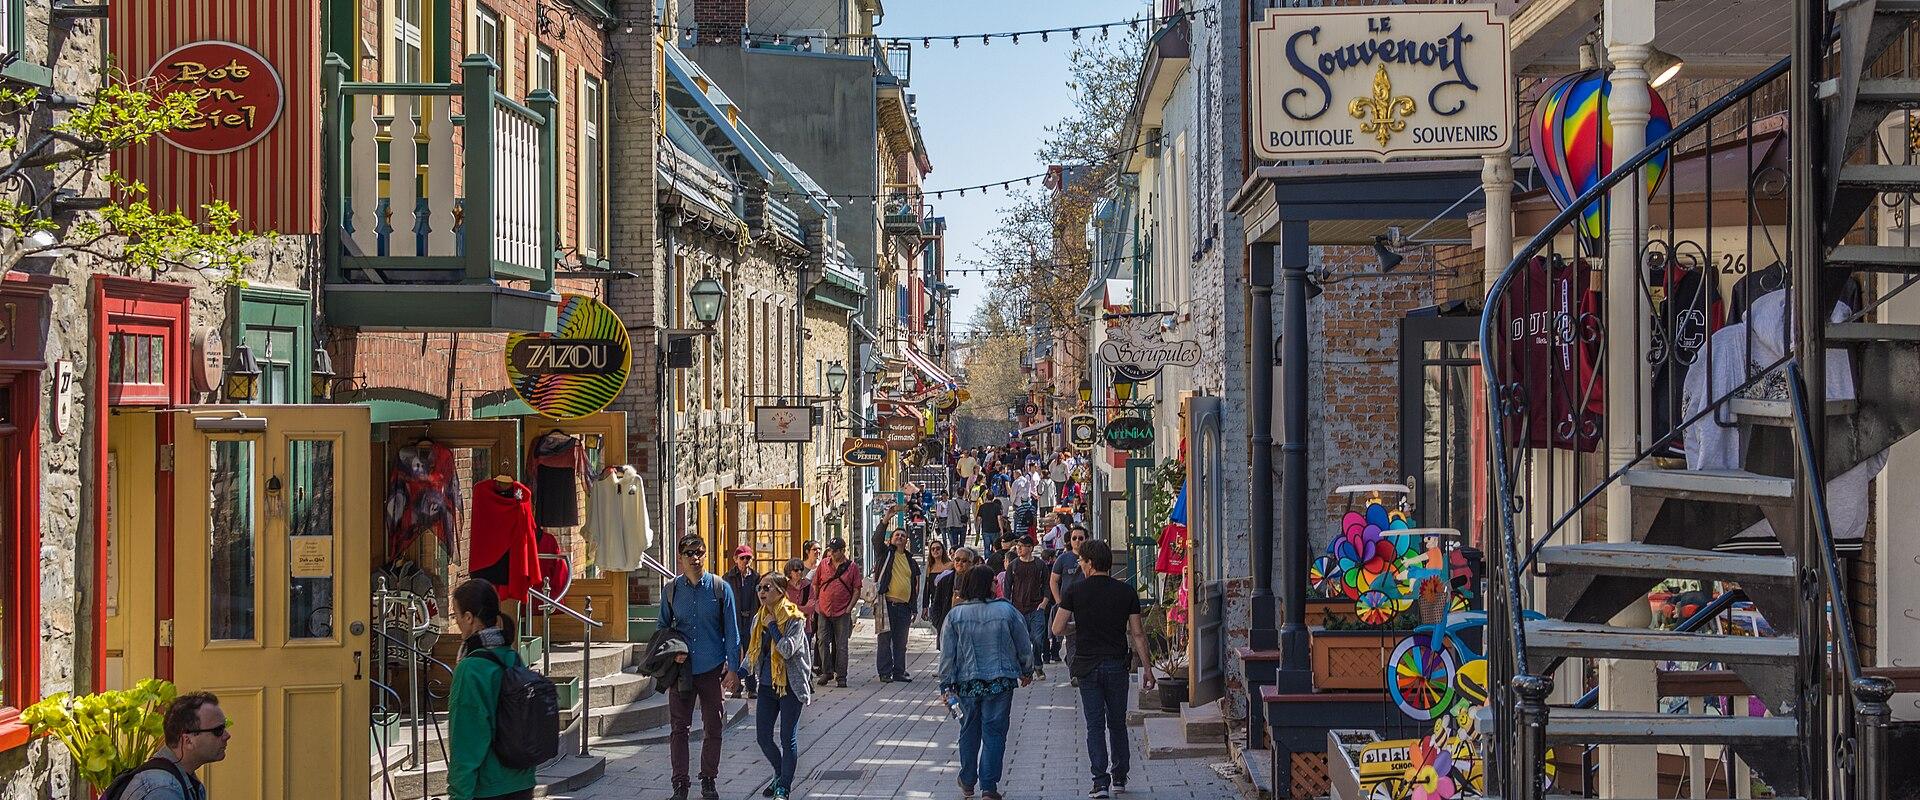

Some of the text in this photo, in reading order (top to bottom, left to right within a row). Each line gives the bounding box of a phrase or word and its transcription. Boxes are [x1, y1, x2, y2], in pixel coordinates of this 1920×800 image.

[1368, 16, 1391, 33] LE
[170, 58, 250, 83] Pot
[189, 86, 245, 101] en
[1269, 125, 1498, 148] BOUTIQUE SOUVENIRS
[1721, 253, 1746, 275] 26
[526, 344, 608, 369] ZAZOU
[1102, 343, 1198, 368] Scrupules
